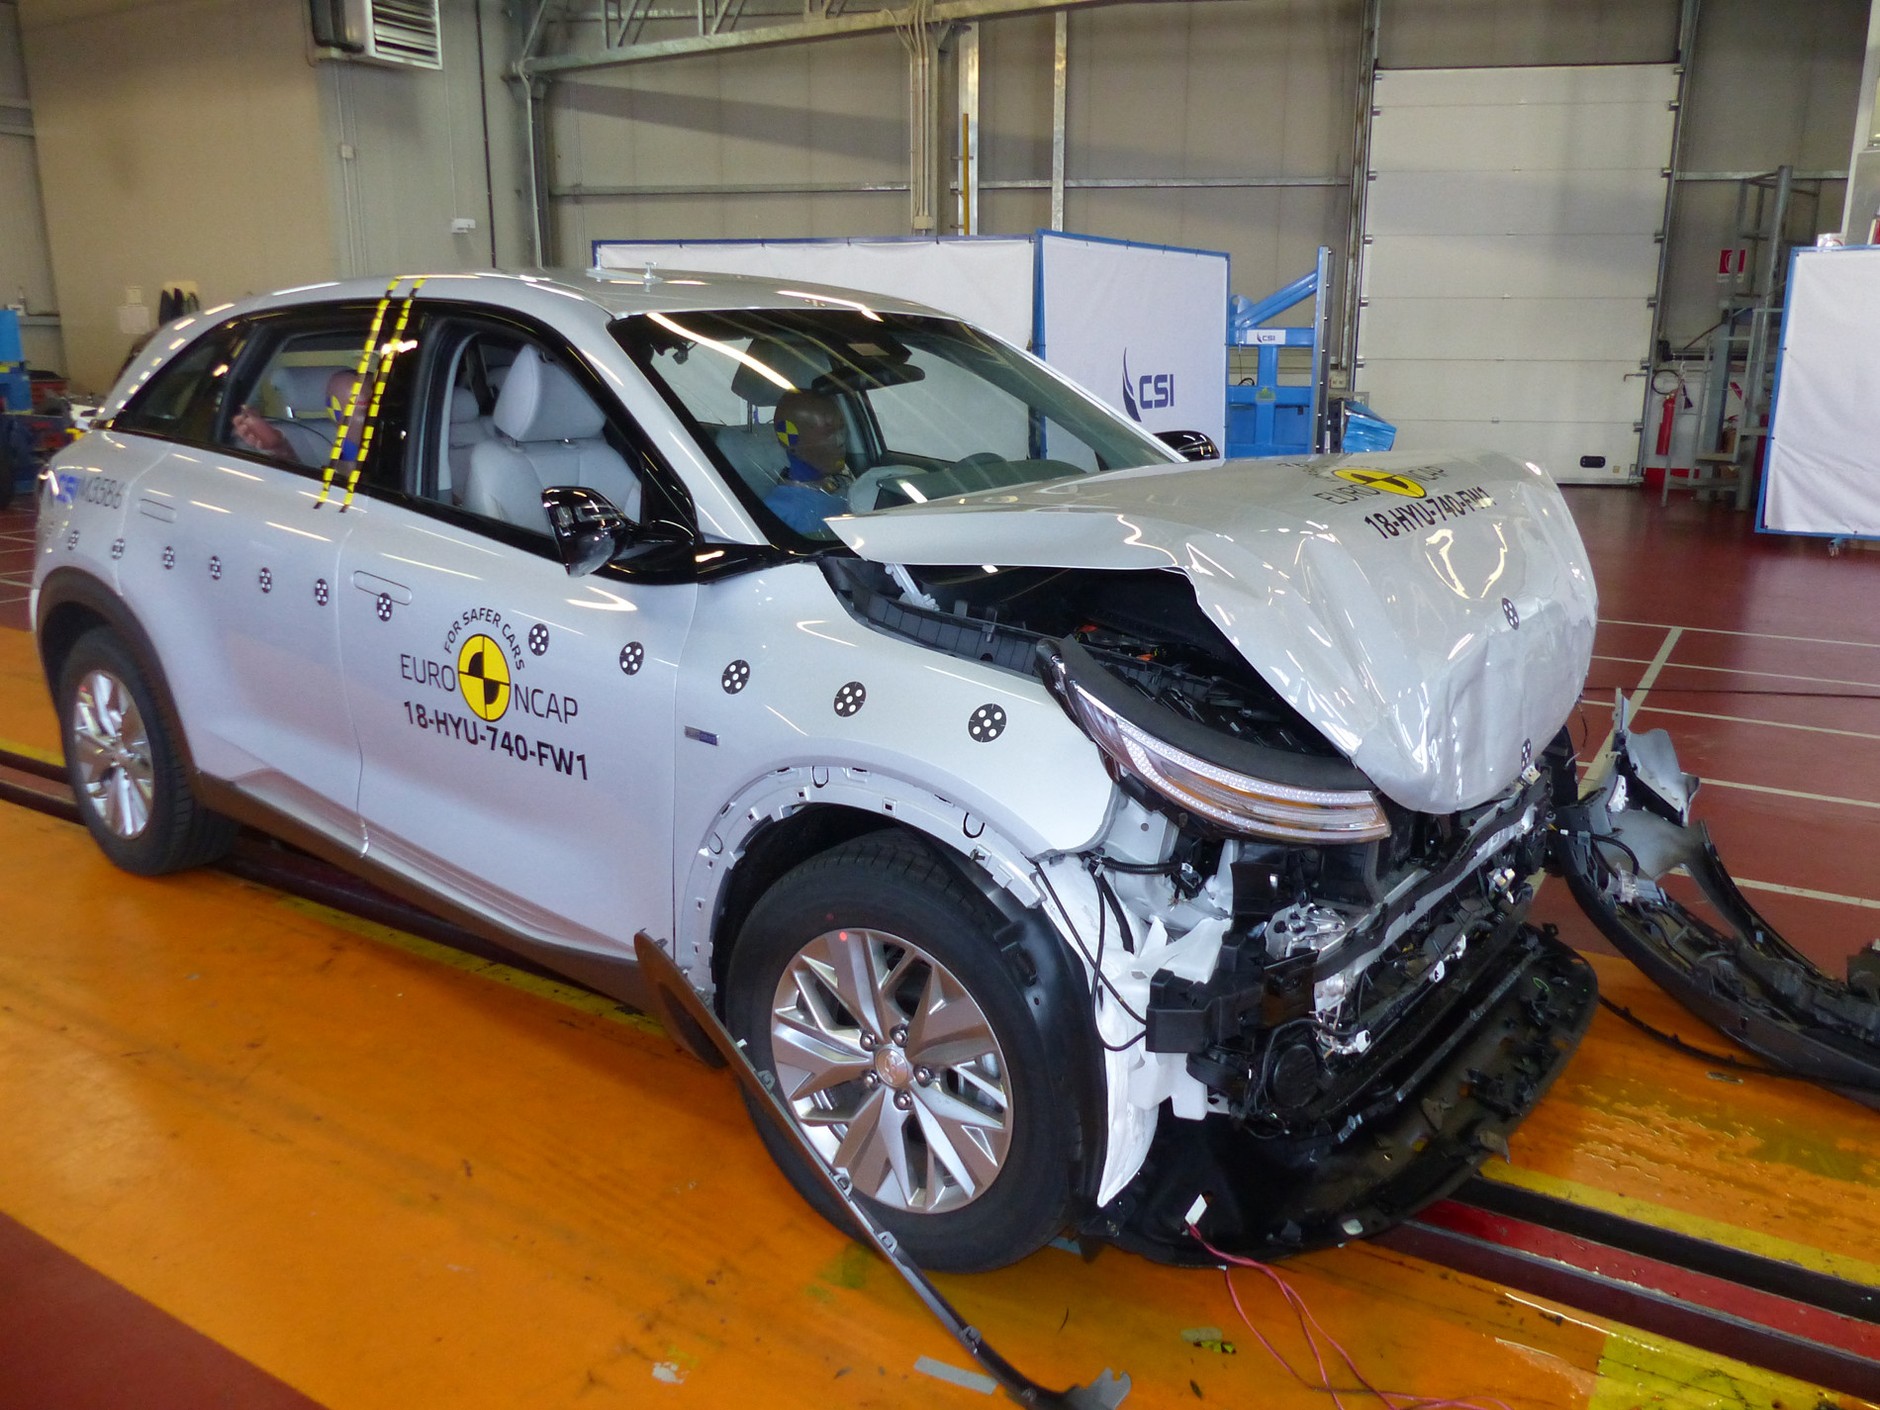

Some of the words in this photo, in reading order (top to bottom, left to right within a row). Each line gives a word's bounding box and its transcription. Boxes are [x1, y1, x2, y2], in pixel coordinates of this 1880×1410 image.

[1139, 374, 1175, 410] CSI
[1313, 485, 1381, 505] EURO
[1364, 486, 1497, 539] 18-HYU-740-FW1
[444, 620, 462, 654] FOR
[462, 607, 502, 628] SAFER
[502, 623, 525, 671] CARS
[401, 653, 457, 693] EURO
[514, 683, 579, 725] NCAP
[404, 701, 588, 781] 18-HYU-740-FW1
